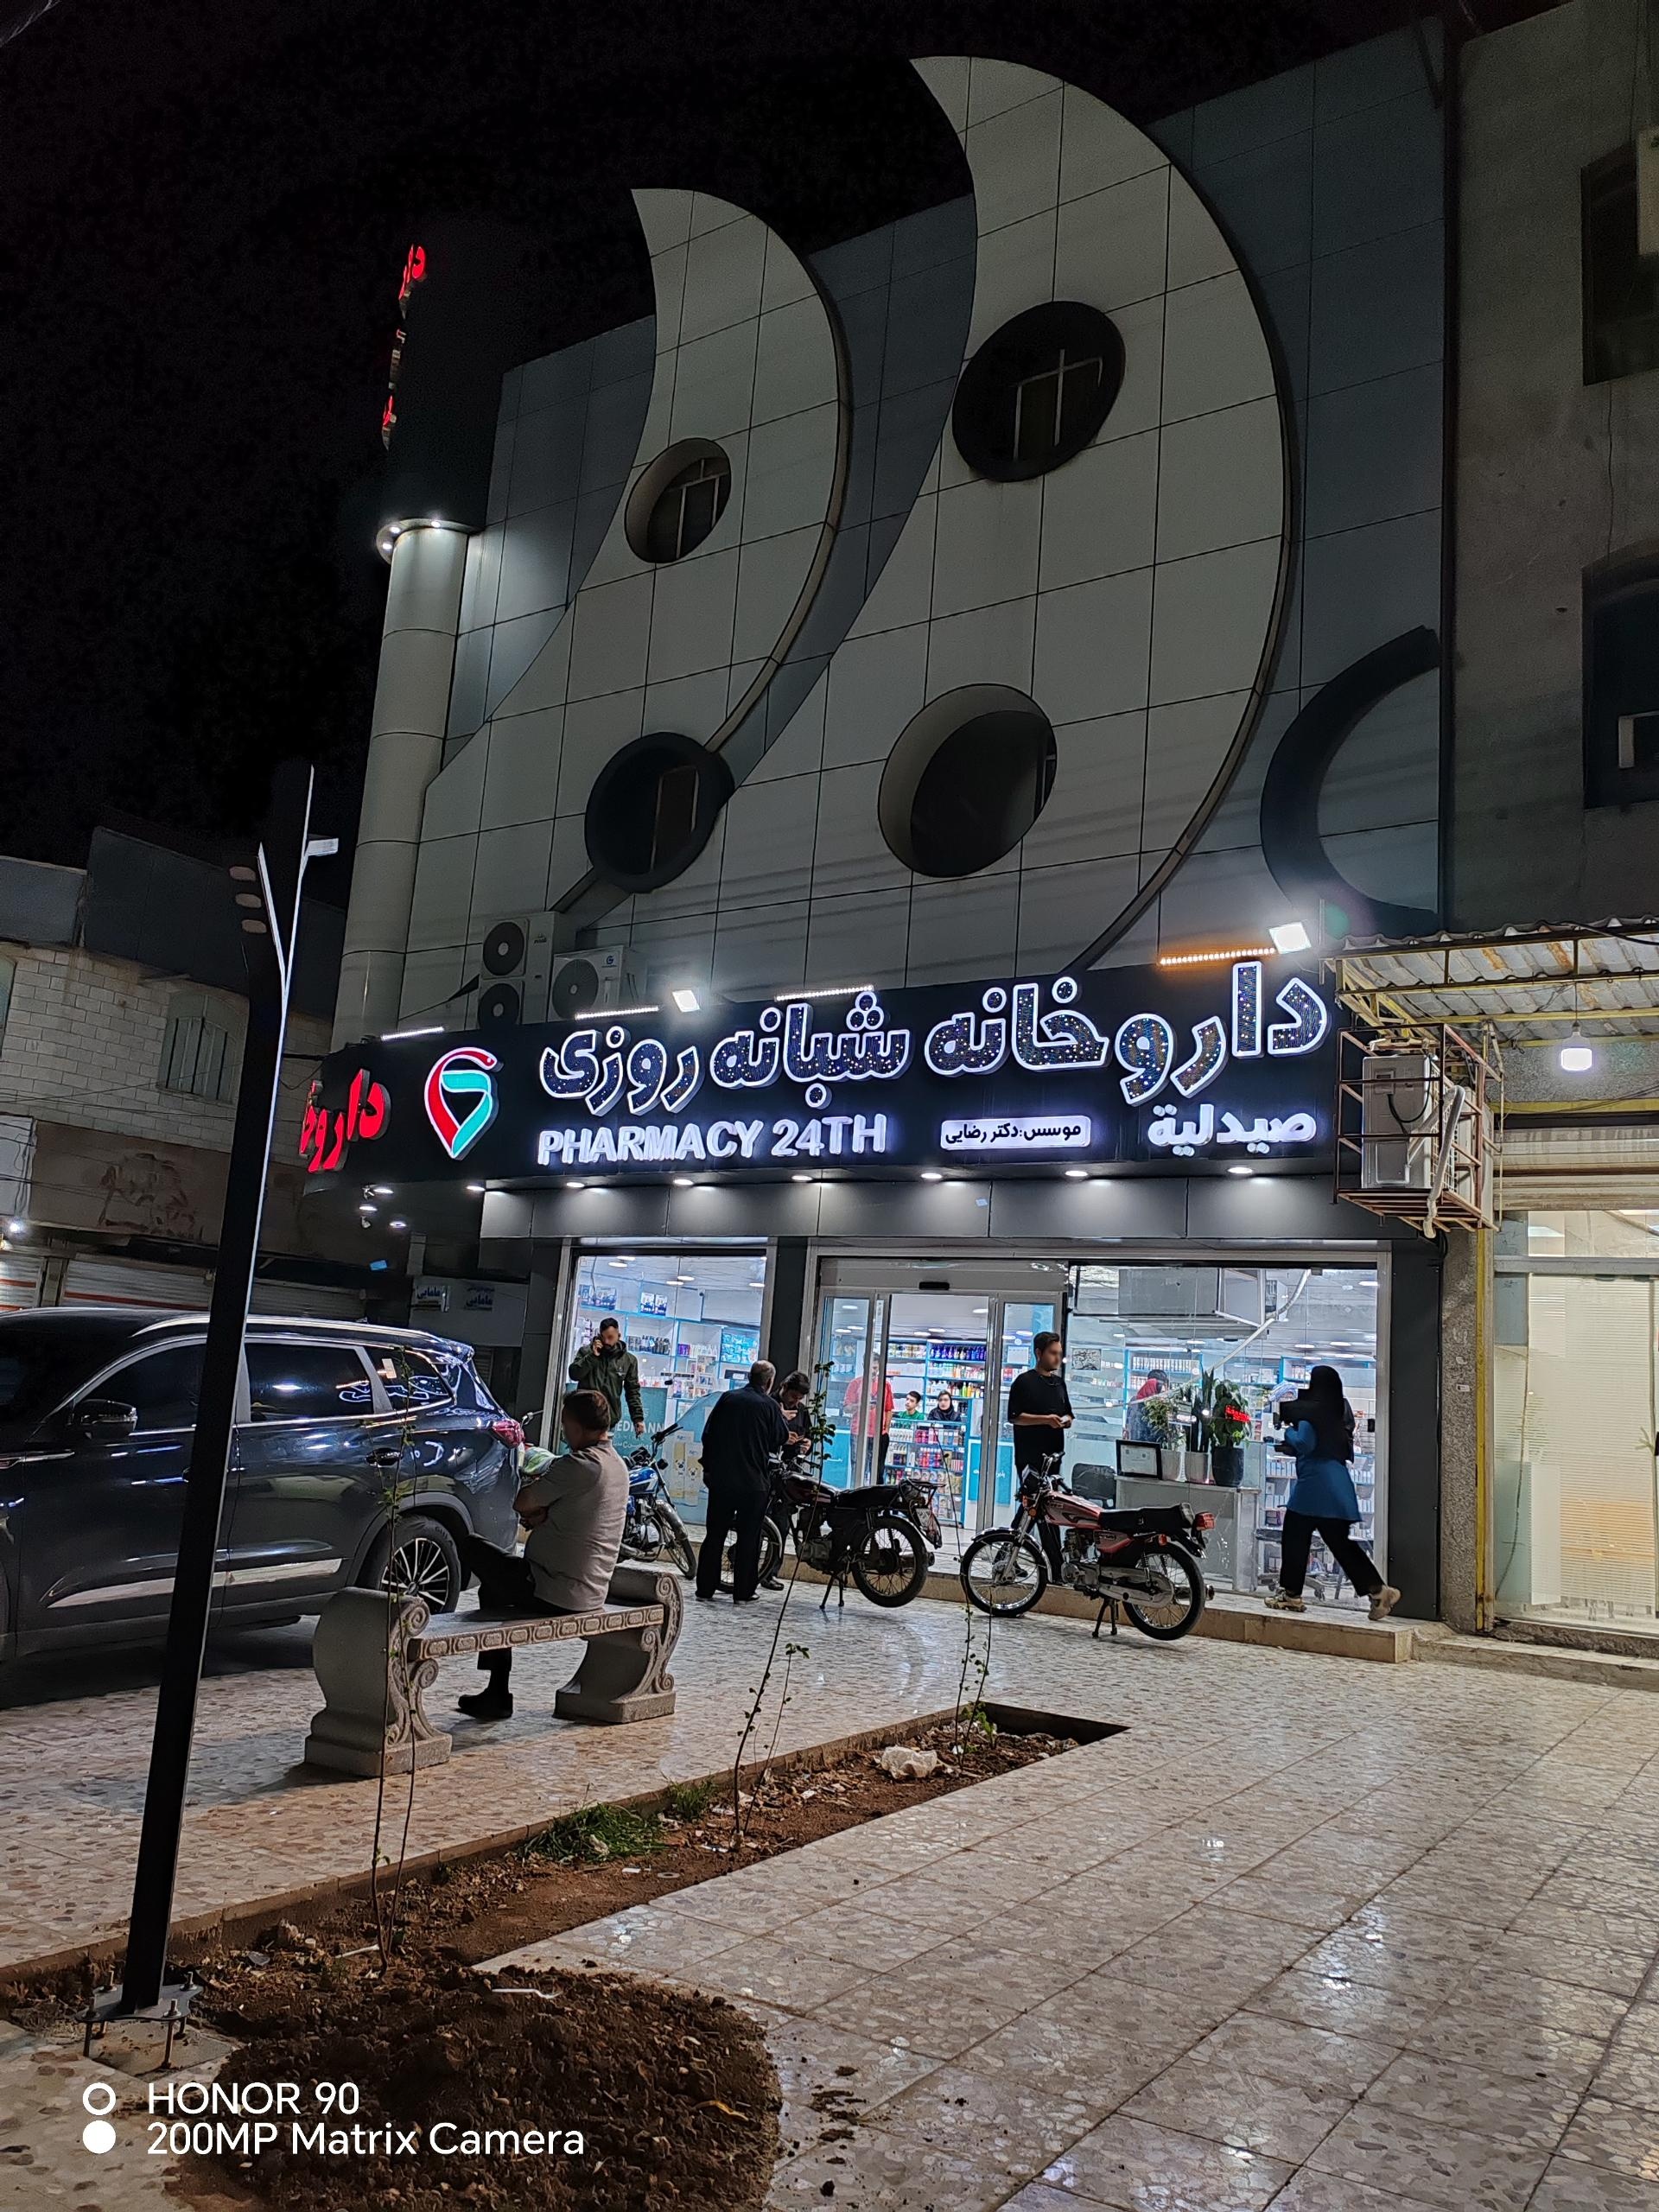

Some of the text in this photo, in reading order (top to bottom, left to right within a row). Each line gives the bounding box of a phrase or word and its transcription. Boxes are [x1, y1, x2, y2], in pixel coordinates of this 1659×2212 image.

[539, 960, 1328, 1116] داروخانه شبانه روزی
[537, 1113, 887, 1166] PHARMACY 24TH
[944, 1123, 988, 1144] رضایی
